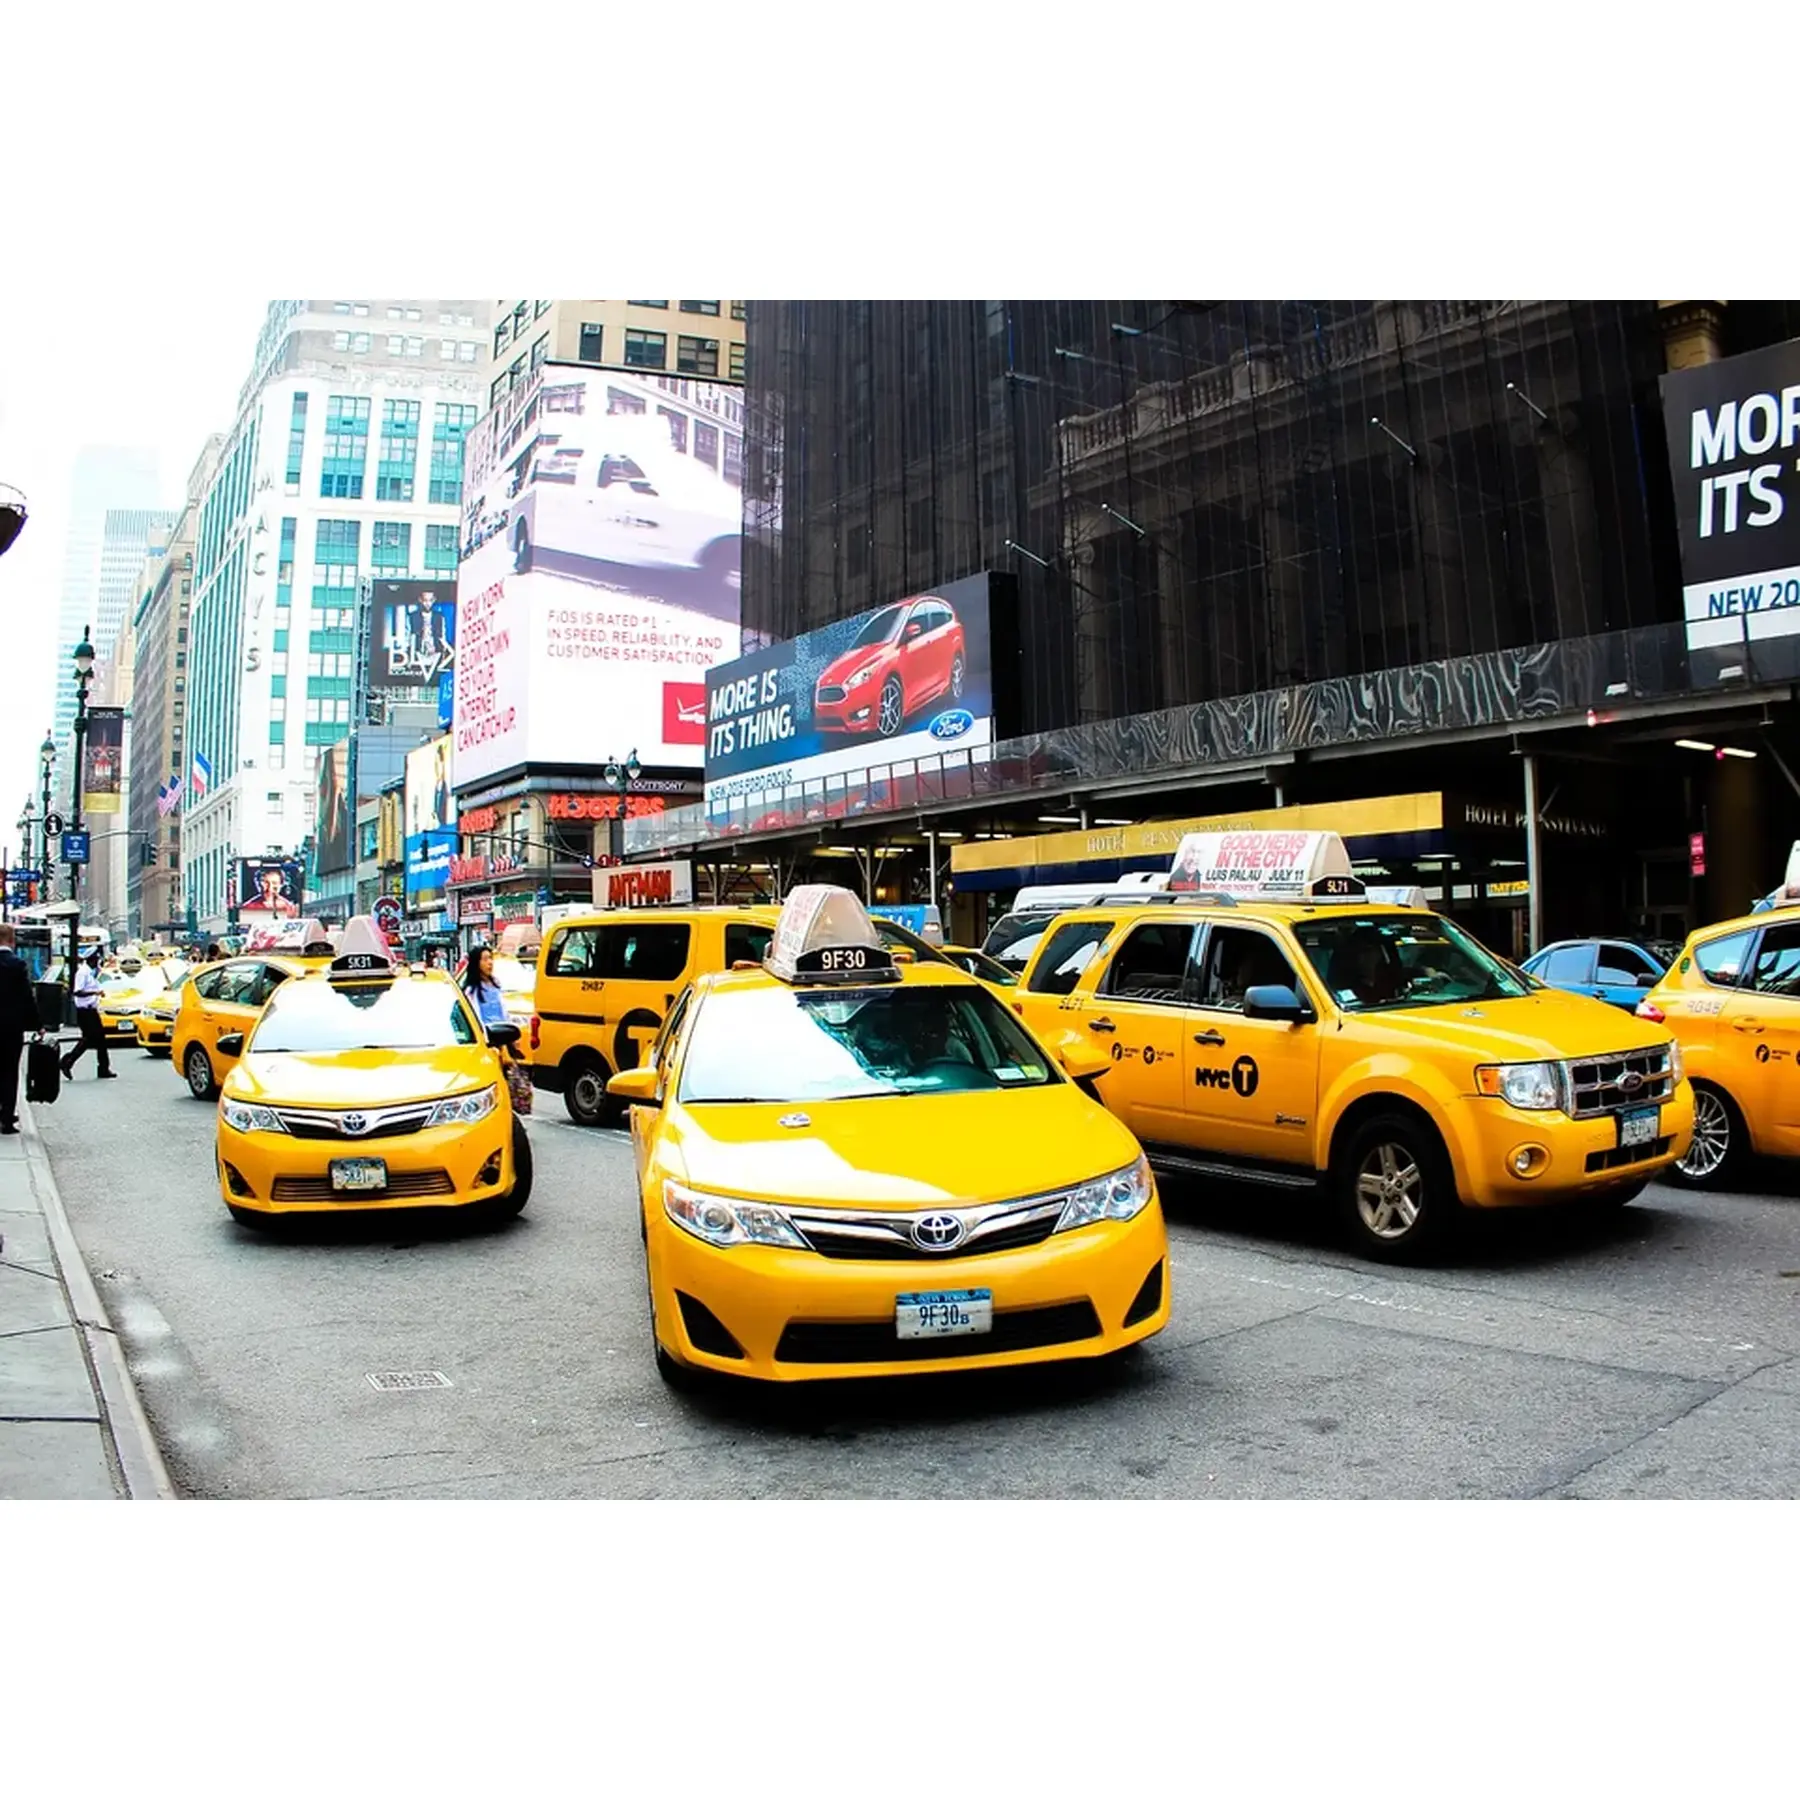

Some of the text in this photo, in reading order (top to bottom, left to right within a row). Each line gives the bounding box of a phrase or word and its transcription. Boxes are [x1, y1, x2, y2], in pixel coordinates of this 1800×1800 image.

[1700, 464, 1783, 538] ITS
[1708, 584, 1763, 618] NEW
[581, 612, 594, 626] IS
[596, 612, 639, 628] RATED
[547, 628, 562, 640] IN
[696, 636, 723, 650] AND
[547, 643, 621, 661] CUSTOMER
[709, 668, 779, 722] MORE IS
[709, 704, 796, 759] ITS THING.
[934, 713, 968, 738] Ford
[1465, 804, 1512, 828] HOTEL
[1220, 832, 1309, 850] GOOD NEWS
[1215, 850, 1300, 869] IN THE CITY
[1205, 869, 1230, 881] LUIS
[1229, 869, 1262, 882] PALAU
[1268, 869, 1293, 881] JULY
[821, 949, 866, 970] 9F30
[1195, 1066, 1232, 1090] NYC
